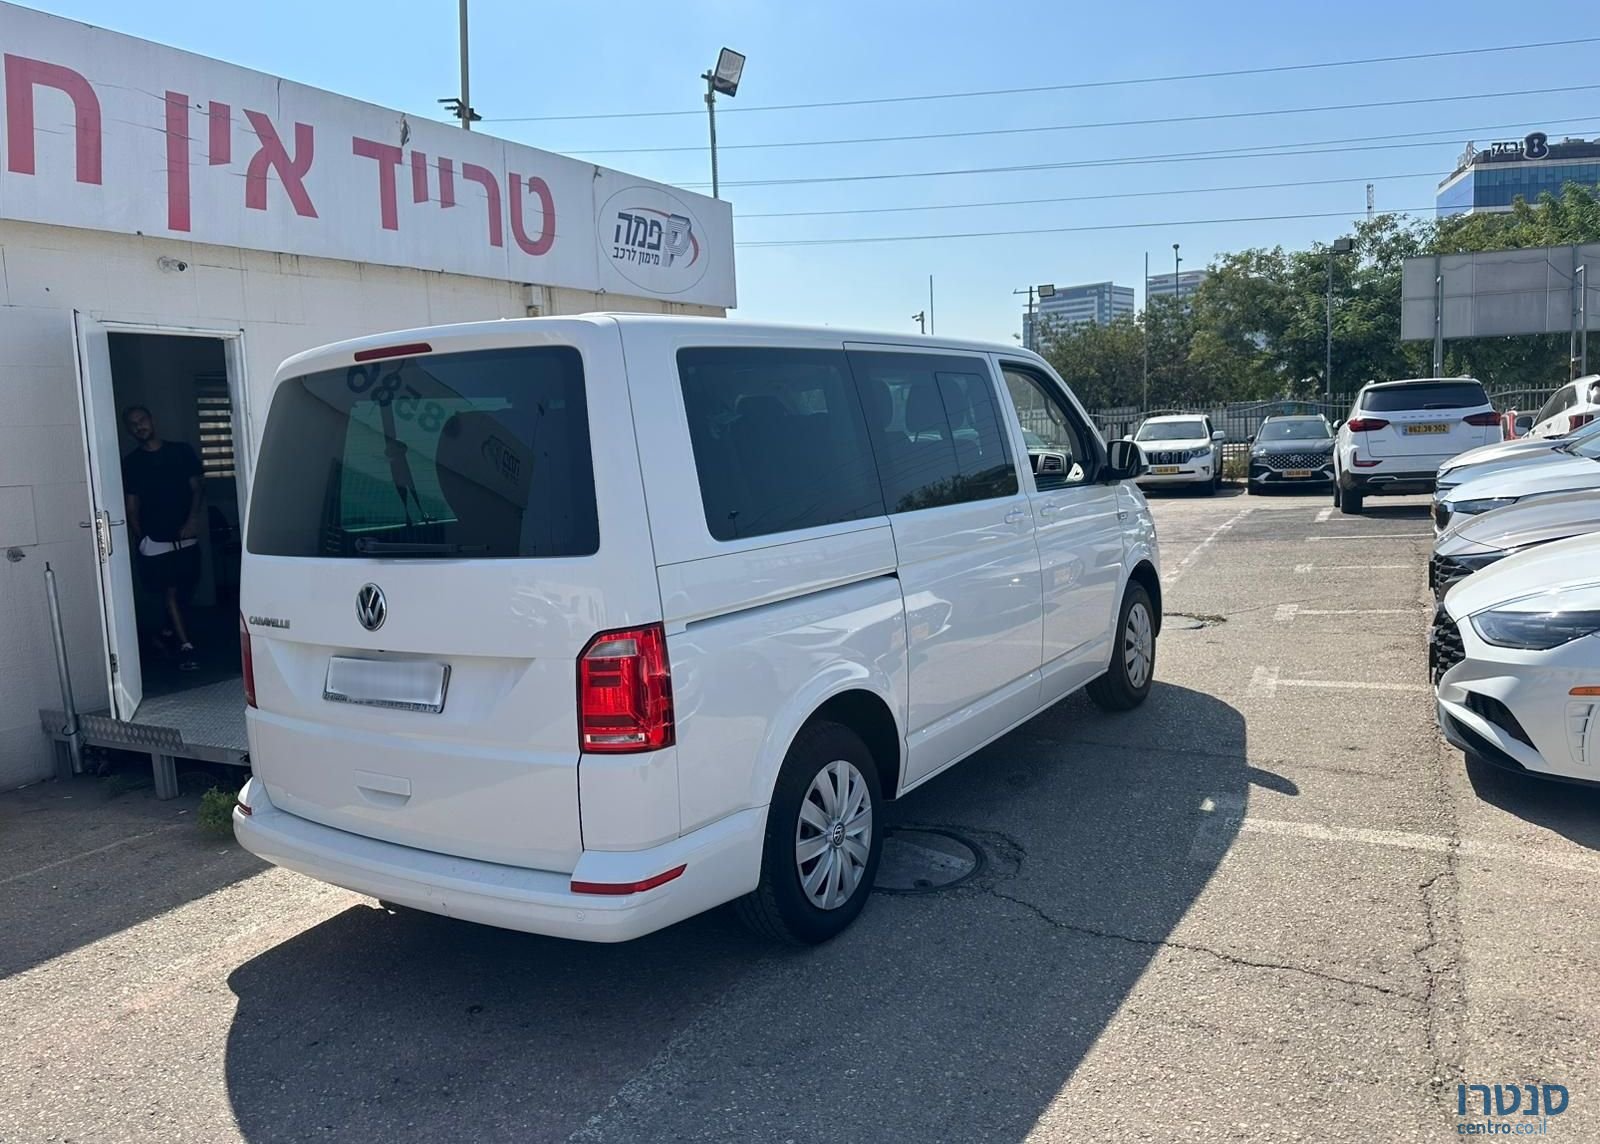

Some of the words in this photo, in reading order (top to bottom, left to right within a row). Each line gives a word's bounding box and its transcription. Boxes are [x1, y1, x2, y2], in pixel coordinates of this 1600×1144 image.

[165, 90, 319, 232] אין
[353, 136, 556, 256] טרייד
[614, 211, 662, 252] פמה
[612, 246, 637, 261] לרכב
[638, 251, 660, 265] מימון
